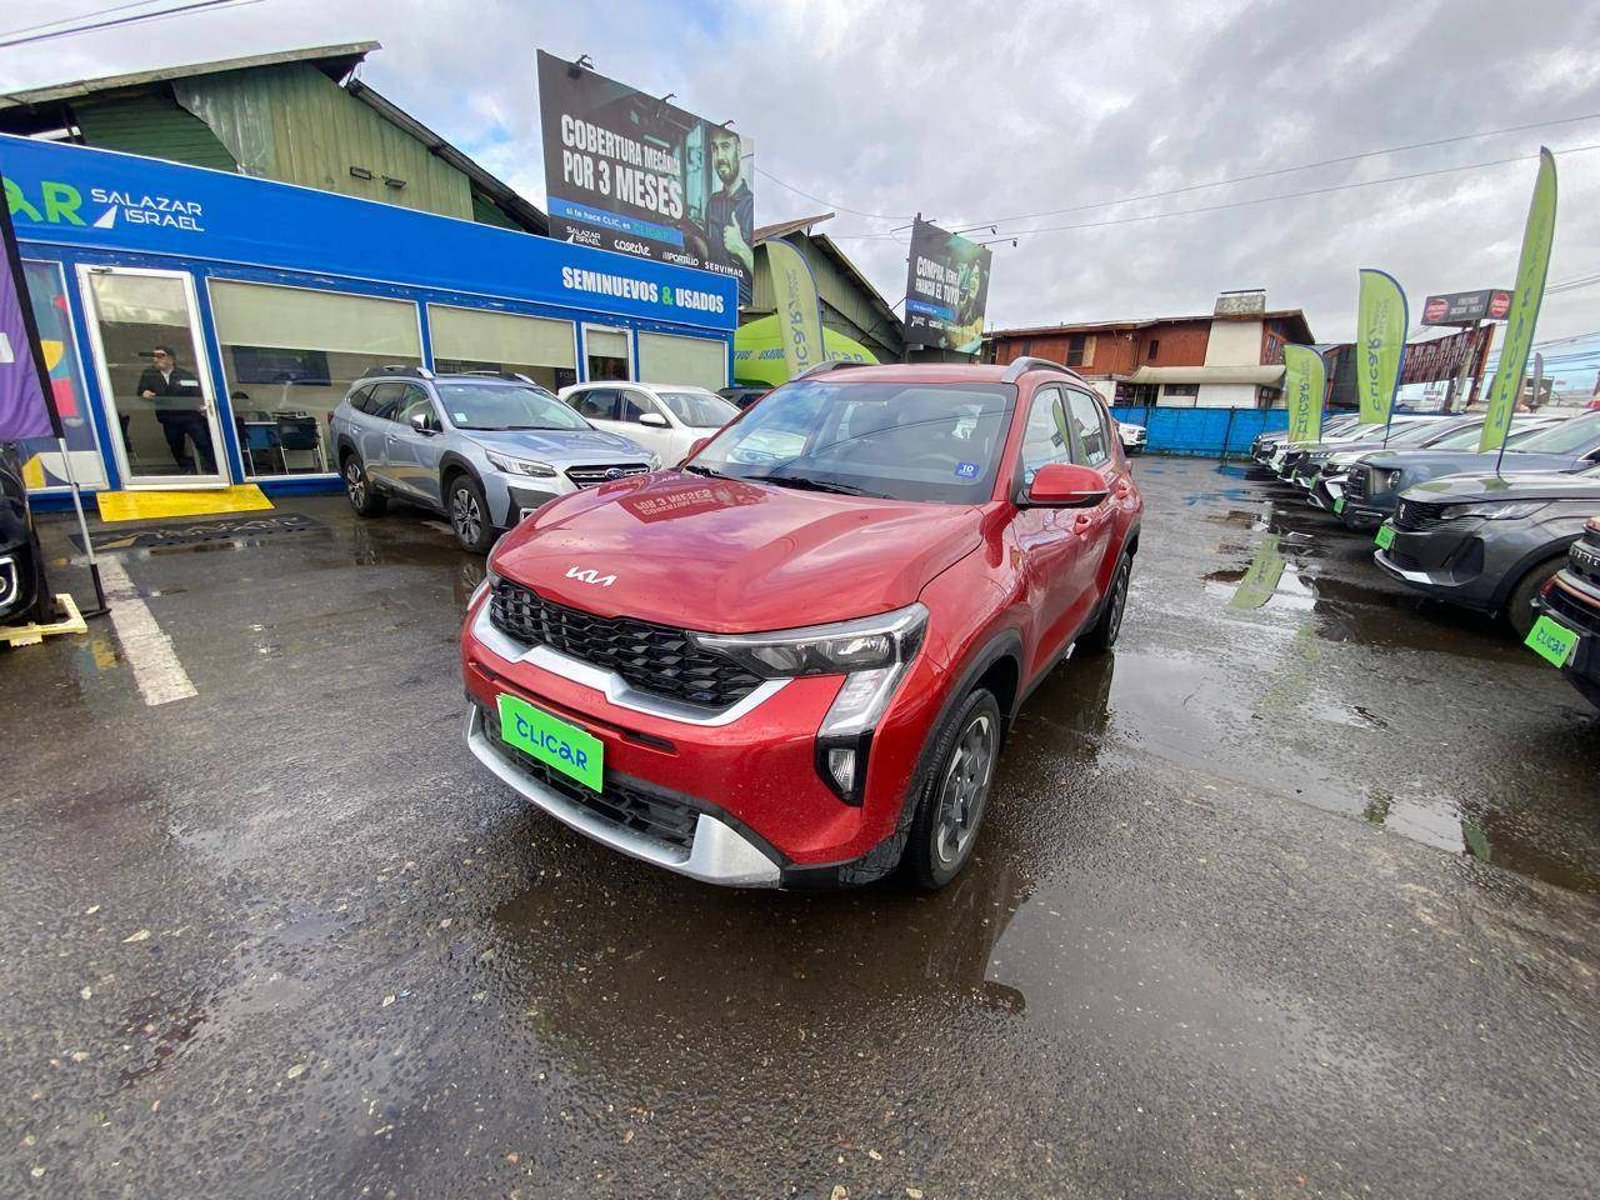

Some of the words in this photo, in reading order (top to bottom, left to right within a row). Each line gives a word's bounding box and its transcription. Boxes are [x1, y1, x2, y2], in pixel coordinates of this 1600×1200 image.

[561, 114, 642, 166] COBERTURA
[90, 188, 202, 216] SALAZAR
[563, 149, 594, 191] POR
[599, 160, 610, 195] 3
[616, 165, 683, 219] MESES
[125, 208, 205, 232] ISRAEL
[561, 266, 658, 304] SEMINUEVOS
[662, 286, 673, 305] &
[675, 287, 725, 314] USADOS
